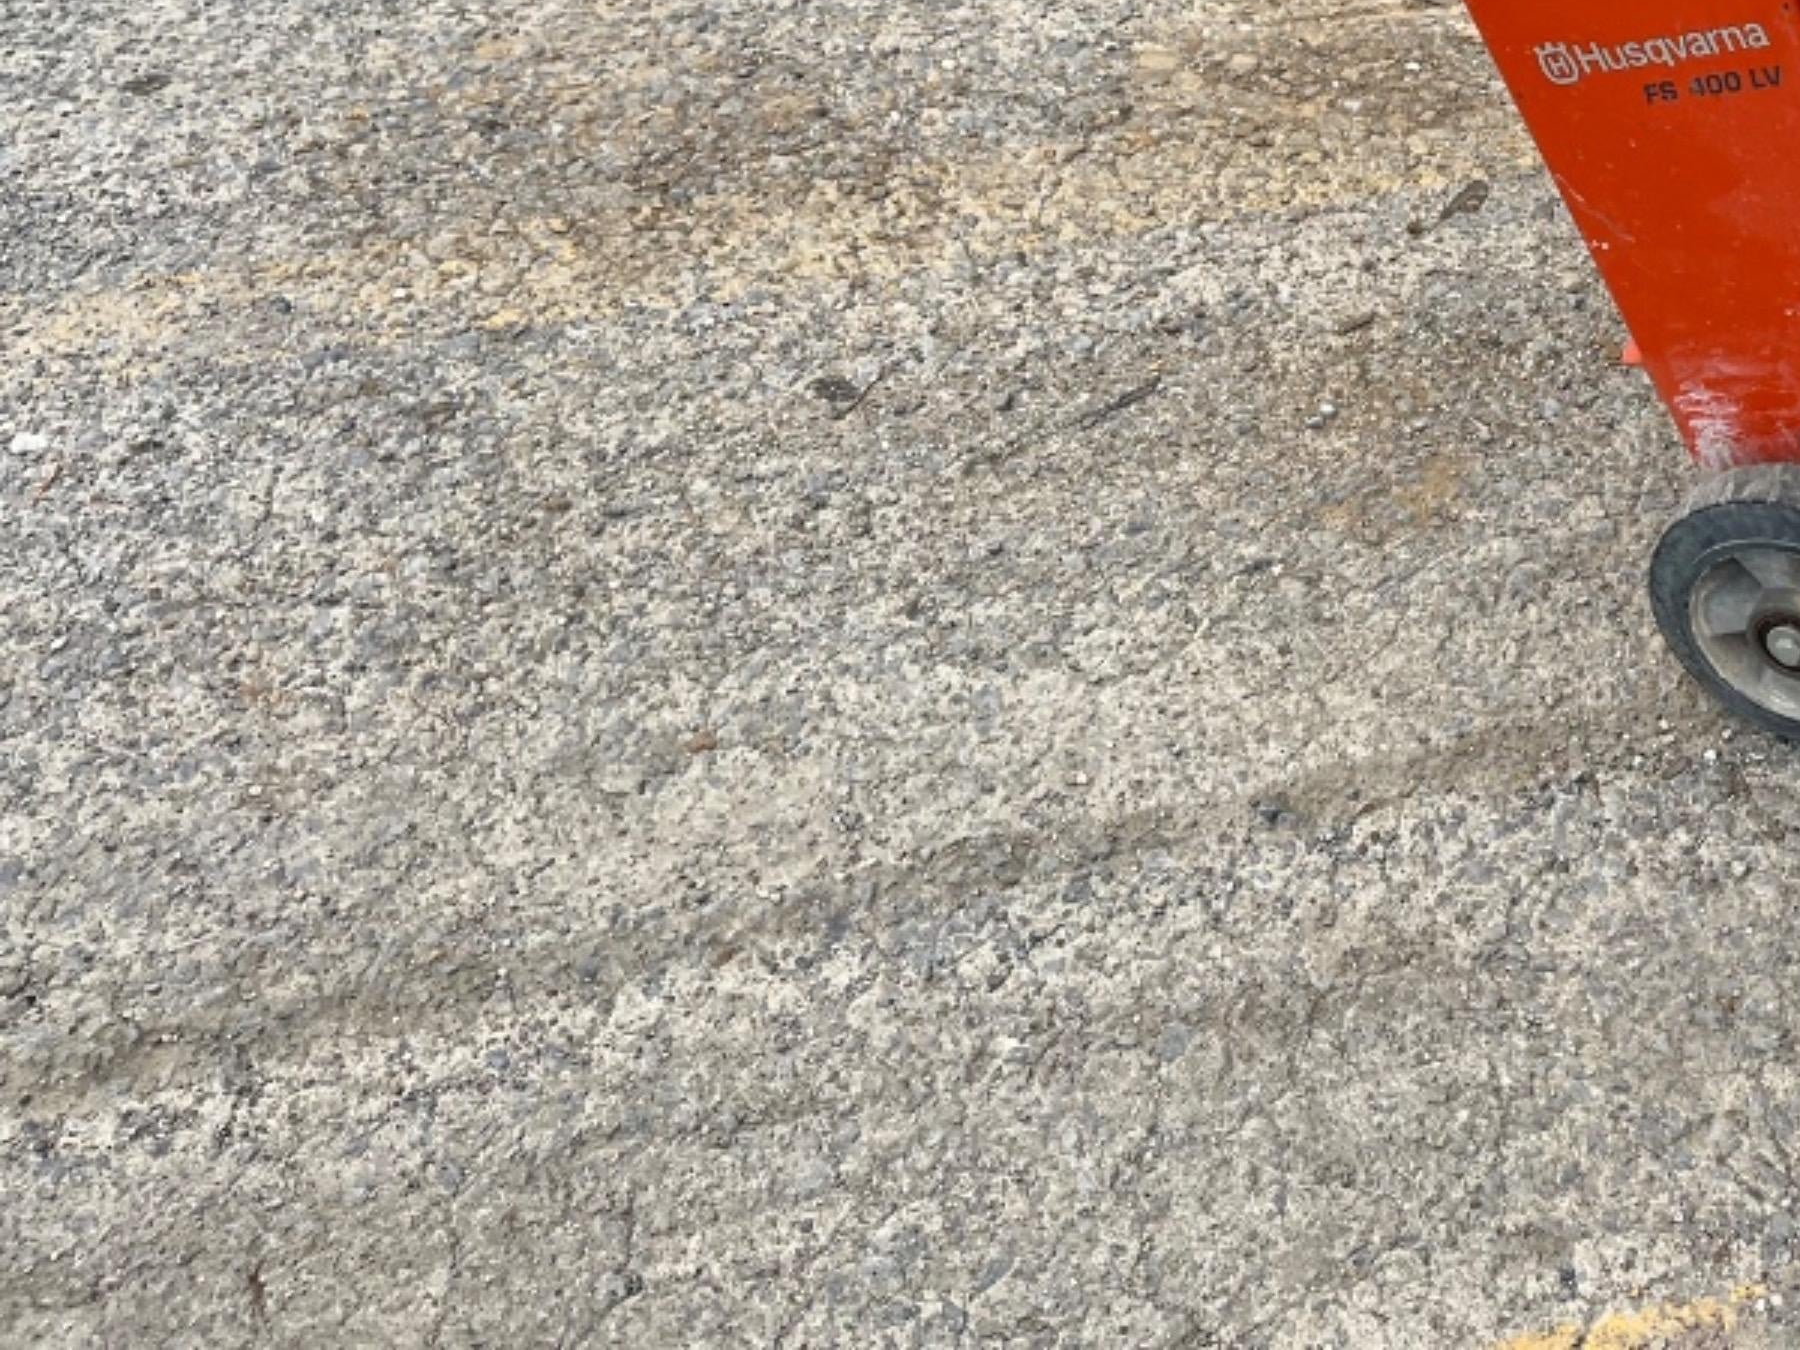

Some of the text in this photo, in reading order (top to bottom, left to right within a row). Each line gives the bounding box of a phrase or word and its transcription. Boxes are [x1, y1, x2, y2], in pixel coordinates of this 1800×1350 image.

[1571, 23, 1770, 74] Husqvarna
[1644, 65, 1780, 105] FS 400 LV
